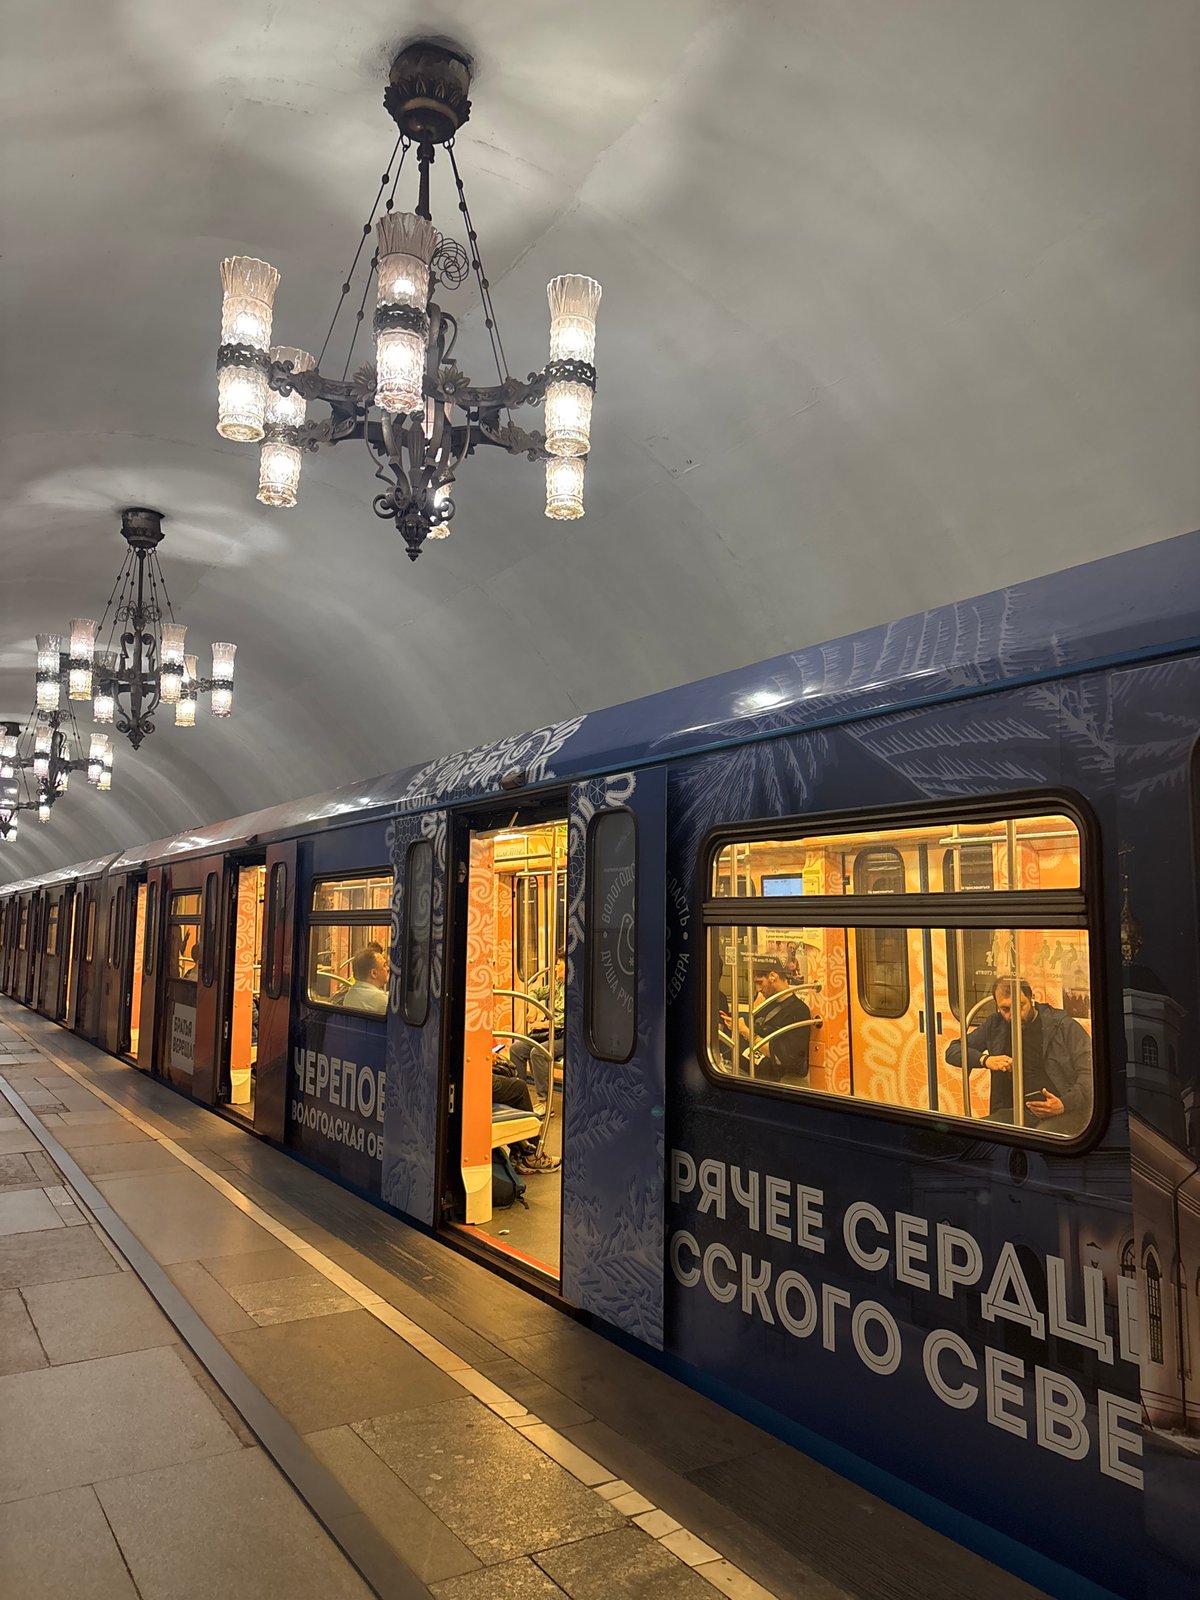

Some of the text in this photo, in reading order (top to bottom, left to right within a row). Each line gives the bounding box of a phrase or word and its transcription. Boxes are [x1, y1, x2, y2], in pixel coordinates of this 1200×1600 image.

[601, 949, 618, 994] ДУША
[292, 1099, 364, 1153] ВОЛОГОДСКАЯ
[671, 1148, 826, 1254] РЯЧЕЕ
[669, 1229, 1145, 1490] ССКОГО СЕВЕ
